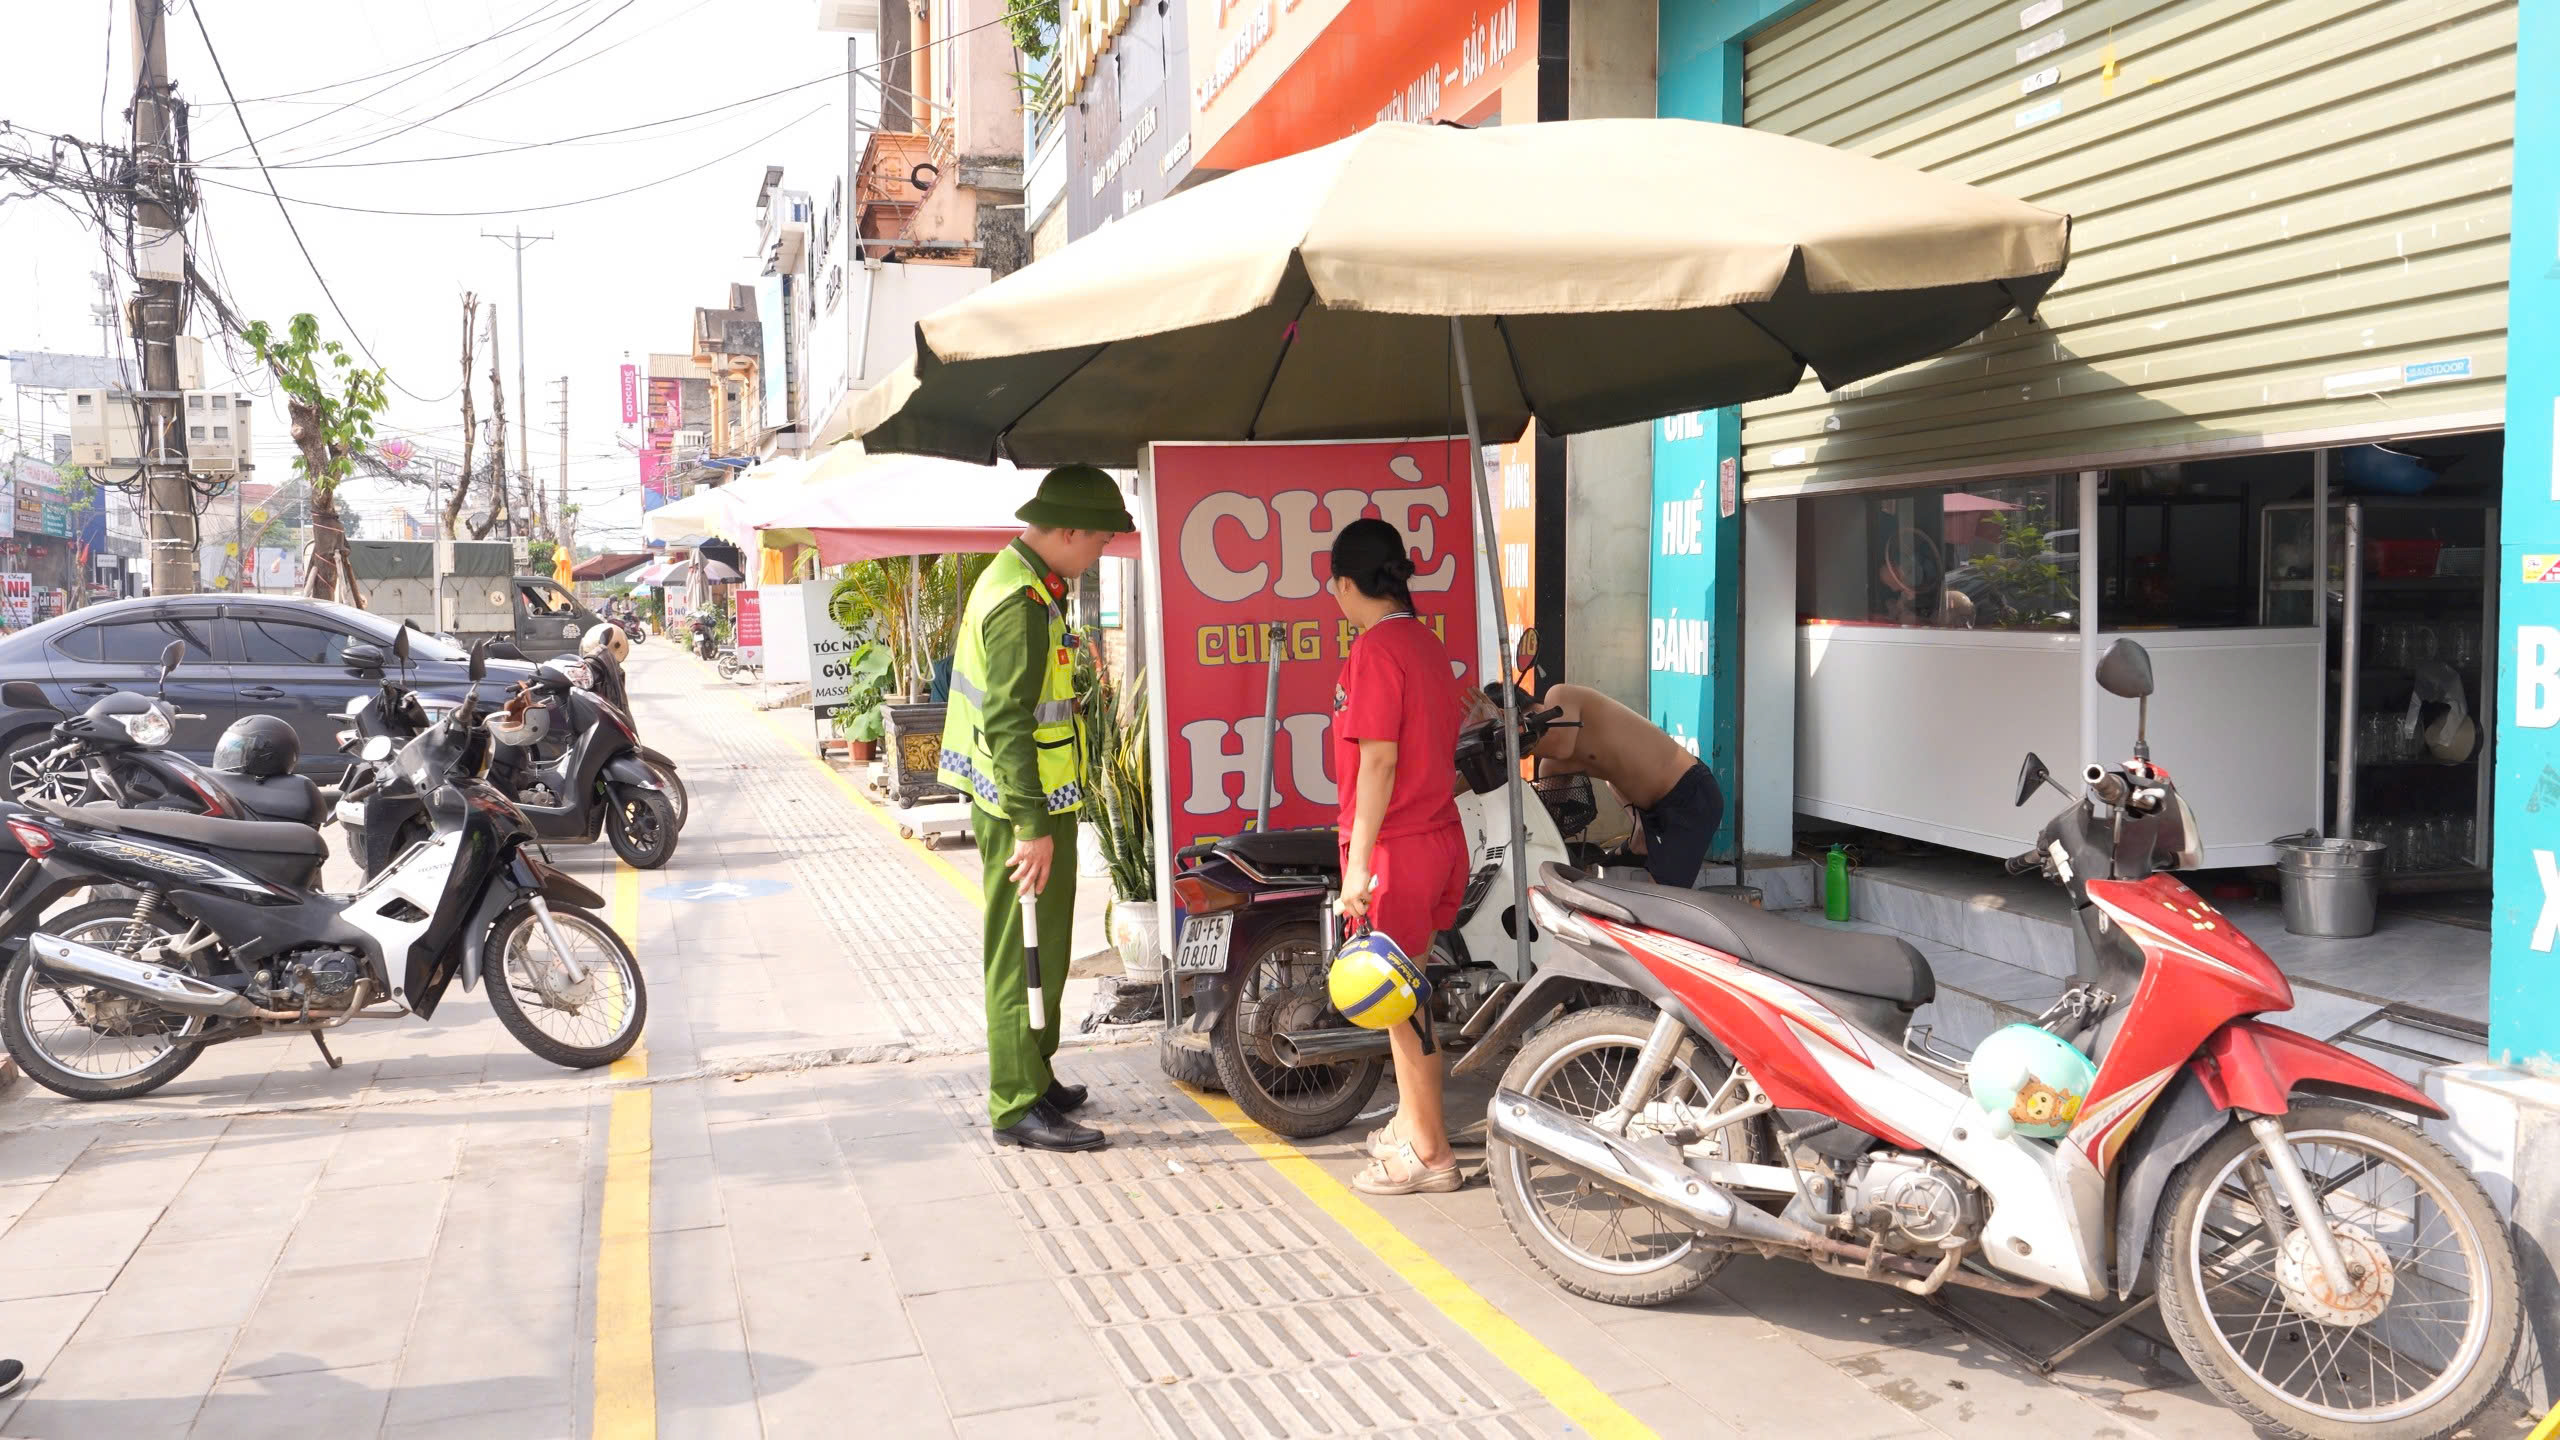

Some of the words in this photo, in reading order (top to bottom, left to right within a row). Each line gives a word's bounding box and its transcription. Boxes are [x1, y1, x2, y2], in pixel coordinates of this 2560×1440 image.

[1463, 10, 1486, 88] BẮC
[1490, 0, 1518, 70] KẠN
[1180, 455, 1457, 603] CHÈ
[1661, 480, 1705, 556] HUẾ
[813, 640, 839, 653] TÓC
[1197, 620, 1321, 666] CUNG
[1651, 609, 1709, 676] BÁNH
